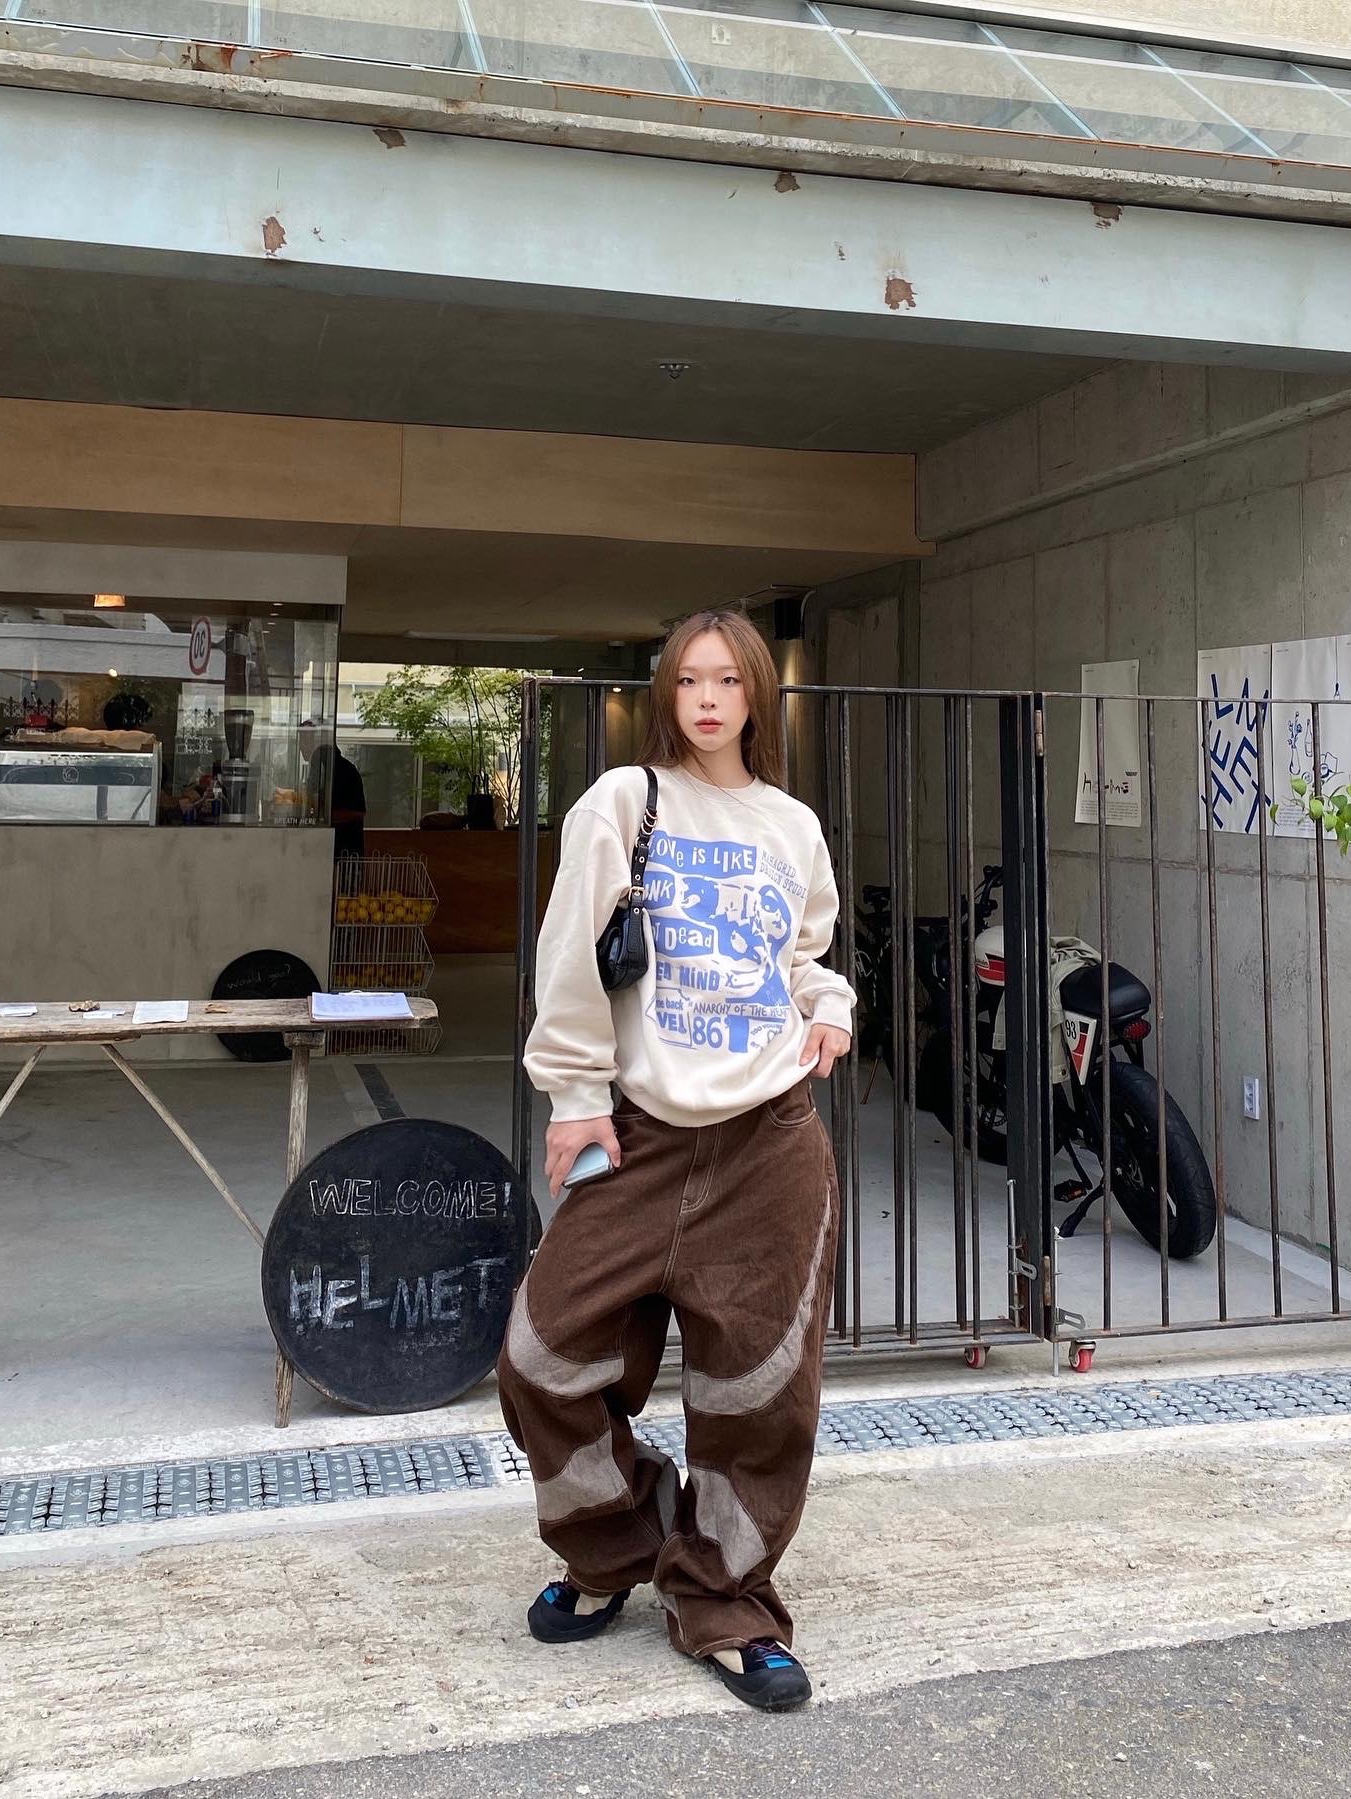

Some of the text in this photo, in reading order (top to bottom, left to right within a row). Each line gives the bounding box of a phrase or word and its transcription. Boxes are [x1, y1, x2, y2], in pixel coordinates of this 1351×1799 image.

[713, 847, 754, 873] LIKE
[734, 1004, 747, 1016] OF
[749, 1005, 767, 1017] THE
[1065, 1020, 1076, 1040] 93
[309, 1178, 511, 1219] WELCOME!
